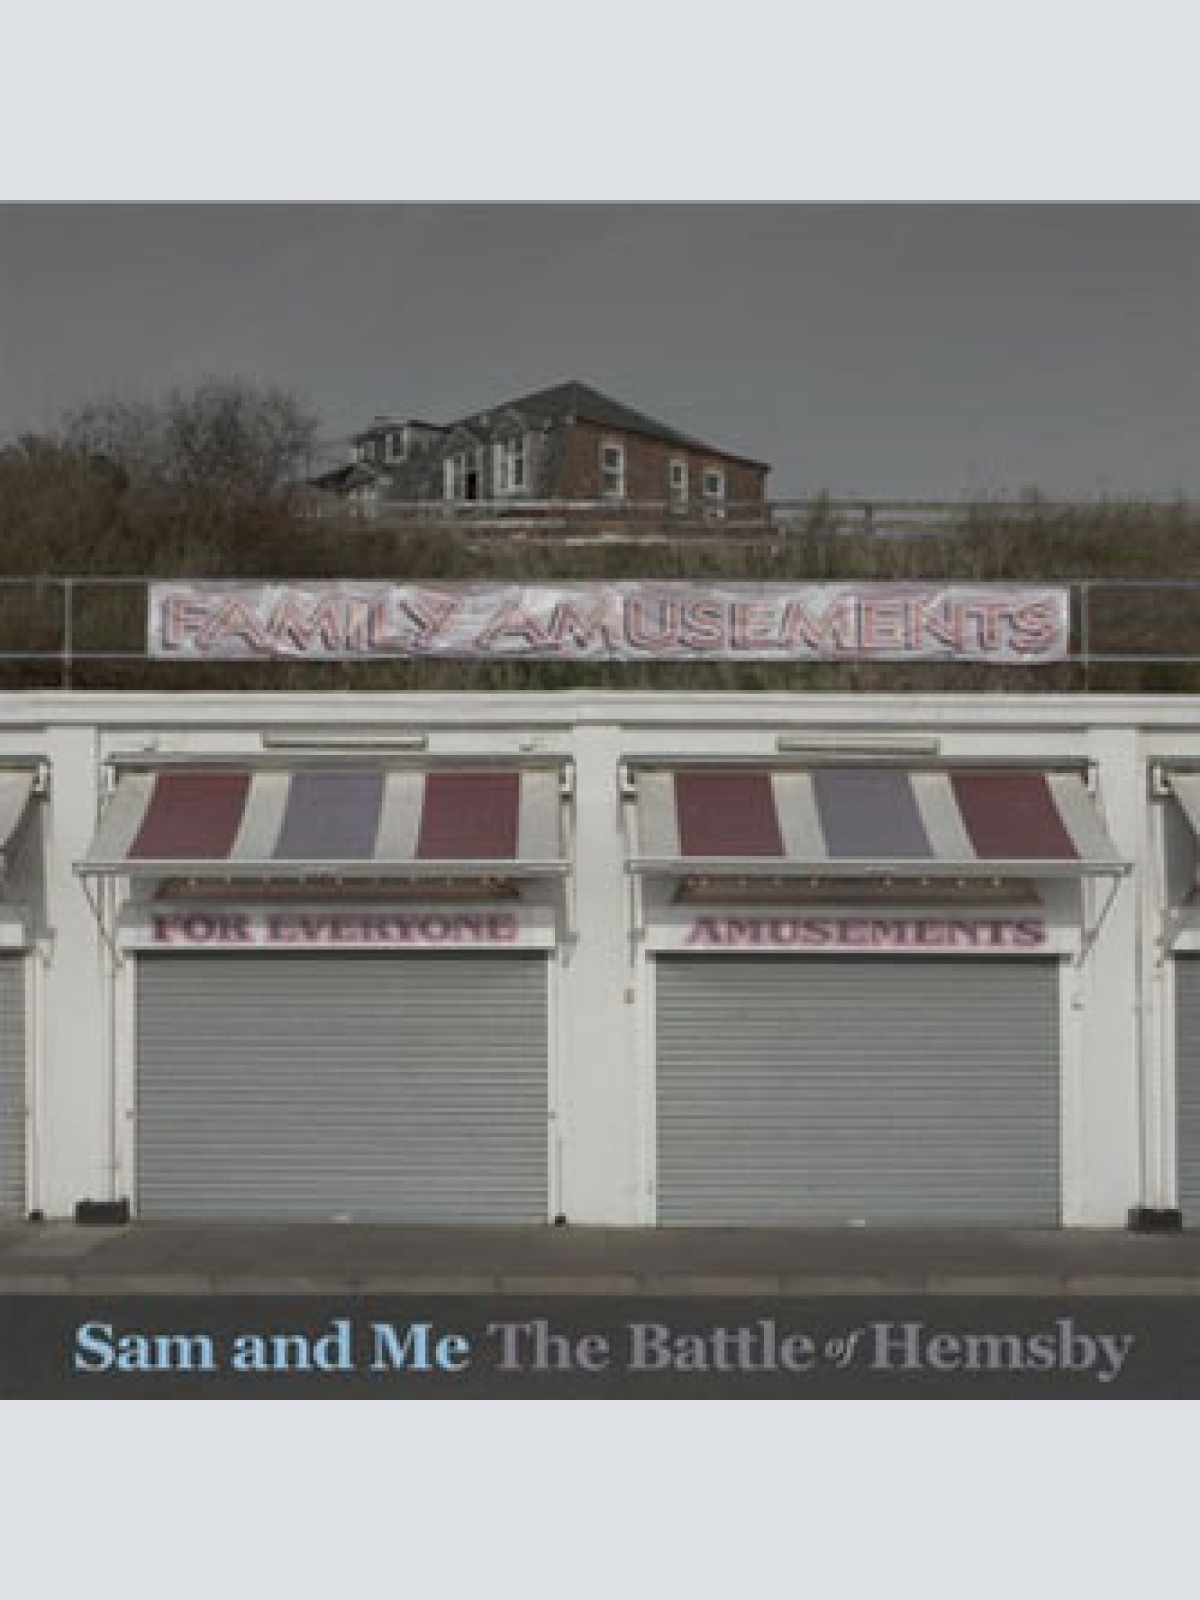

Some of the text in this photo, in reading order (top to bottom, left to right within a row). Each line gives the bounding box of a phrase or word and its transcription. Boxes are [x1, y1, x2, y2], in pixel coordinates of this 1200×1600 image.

[161, 597, 1056, 654] FAMILY AMUSEMENTS
[152, 913, 520, 943] FOR EVERYONE
[687, 916, 1047, 947] AMUSEMENTS
